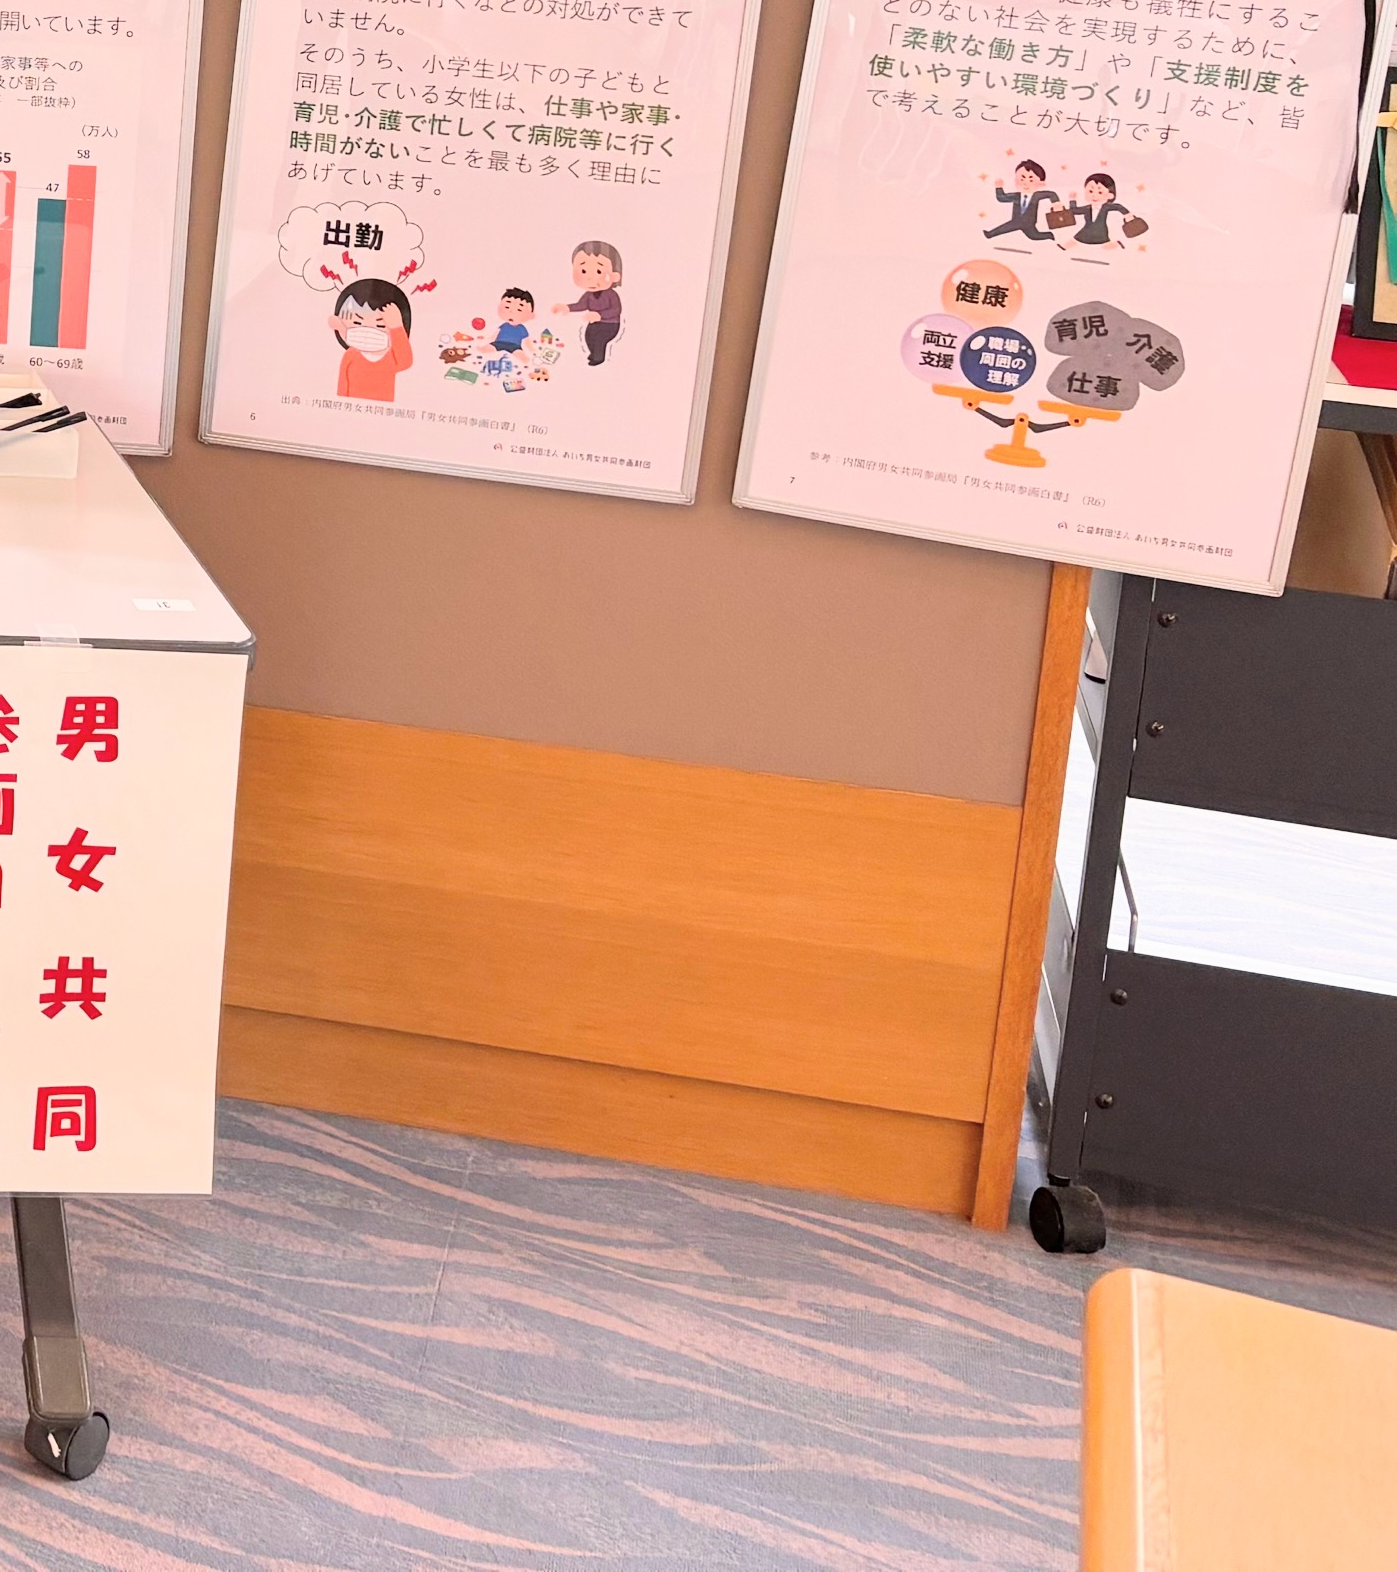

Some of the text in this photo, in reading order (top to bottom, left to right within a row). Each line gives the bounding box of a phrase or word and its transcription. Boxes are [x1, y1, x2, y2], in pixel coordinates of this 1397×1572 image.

[303, 7, 406, 37] いません。
[299, 42, 672, 96] そのうち、小学生以下の子どもと
[865, 86, 1193, 151] で考えることが大切です。
[76, 149, 90, 159] 58
[289, 129, 661, 187] 時間がないことを最も多く理由に
[46, 182, 60, 193] 47
[286, 159, 444, 197] あげています。
[323, 220, 384, 253] 出勤
[955, 280, 1009, 308] 健康
[923, 330, 957, 349] 両立
[1052, 315, 1109, 342] 育児
[919, 351, 954, 370] 支援
[979, 352, 1027, 370] 周囲の
[1126, 332, 1179, 375] 介護
[987, 371, 1020, 386] 理解
[1067, 371, 1122, 398] 仕事
[33, 696, 119, 1152] 男女共同
